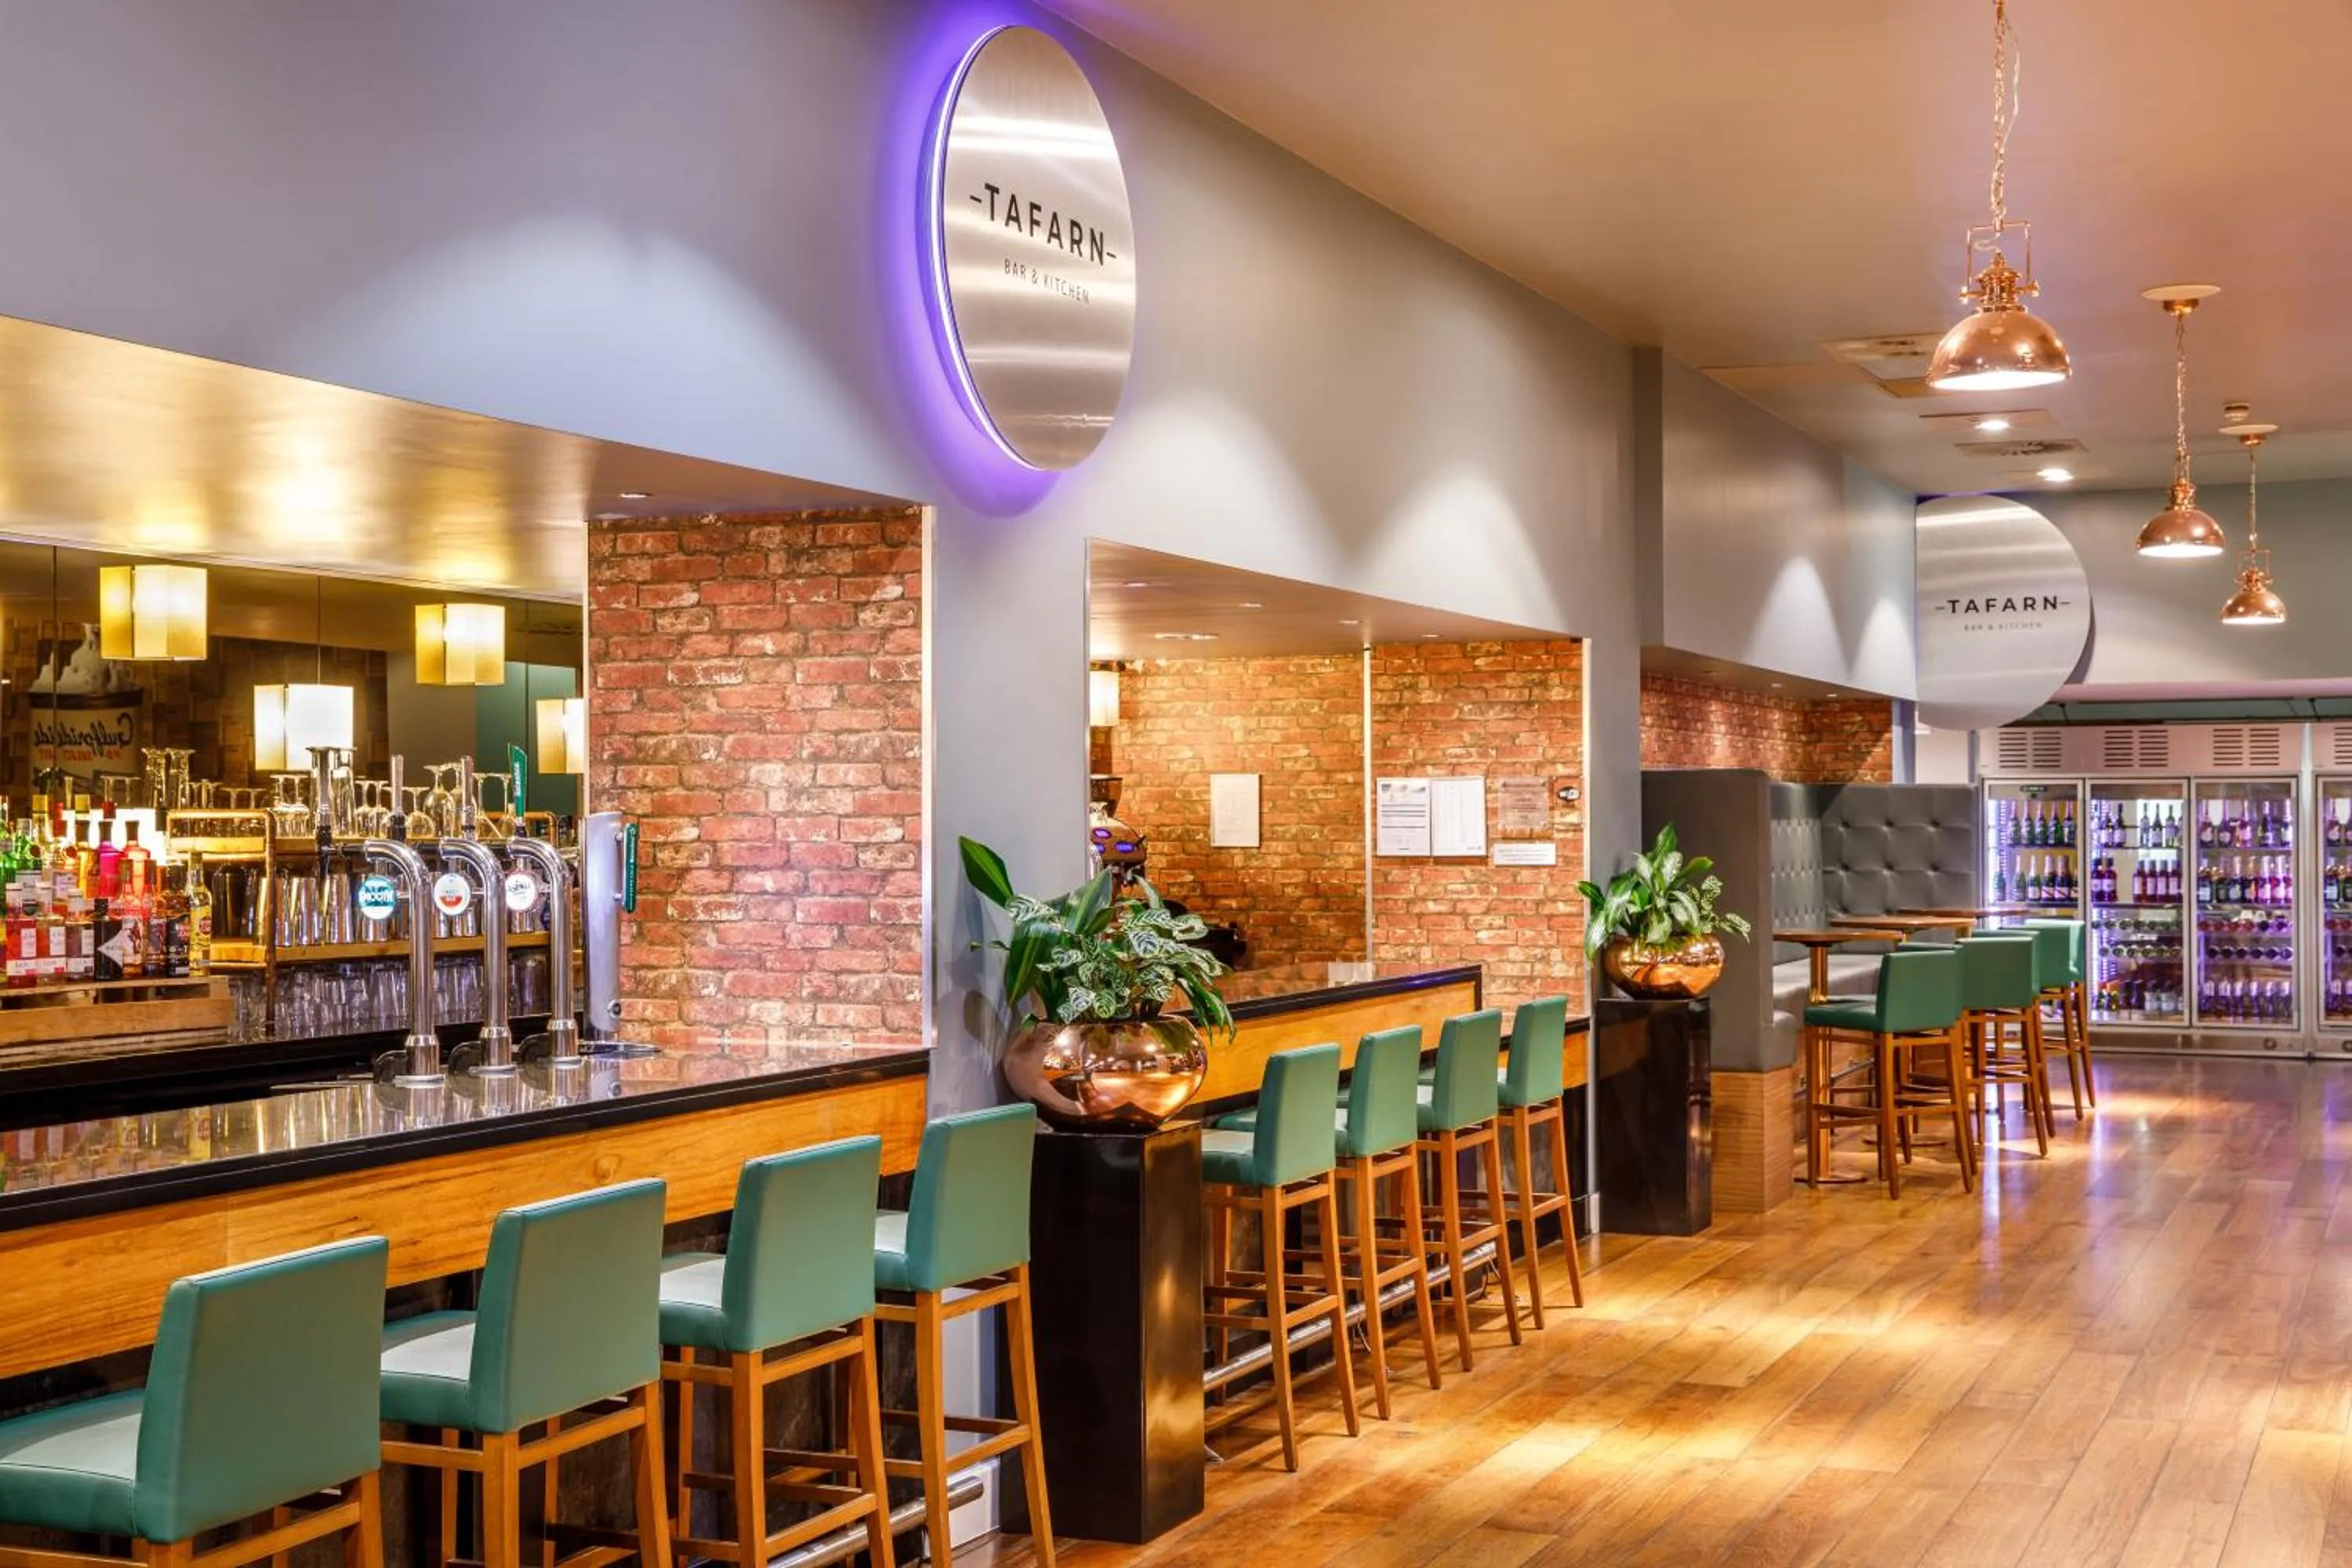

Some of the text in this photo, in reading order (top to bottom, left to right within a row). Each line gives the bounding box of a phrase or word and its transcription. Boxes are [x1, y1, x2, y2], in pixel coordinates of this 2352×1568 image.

[1004, 258, 1090, 304] BAR & KITCHEN
